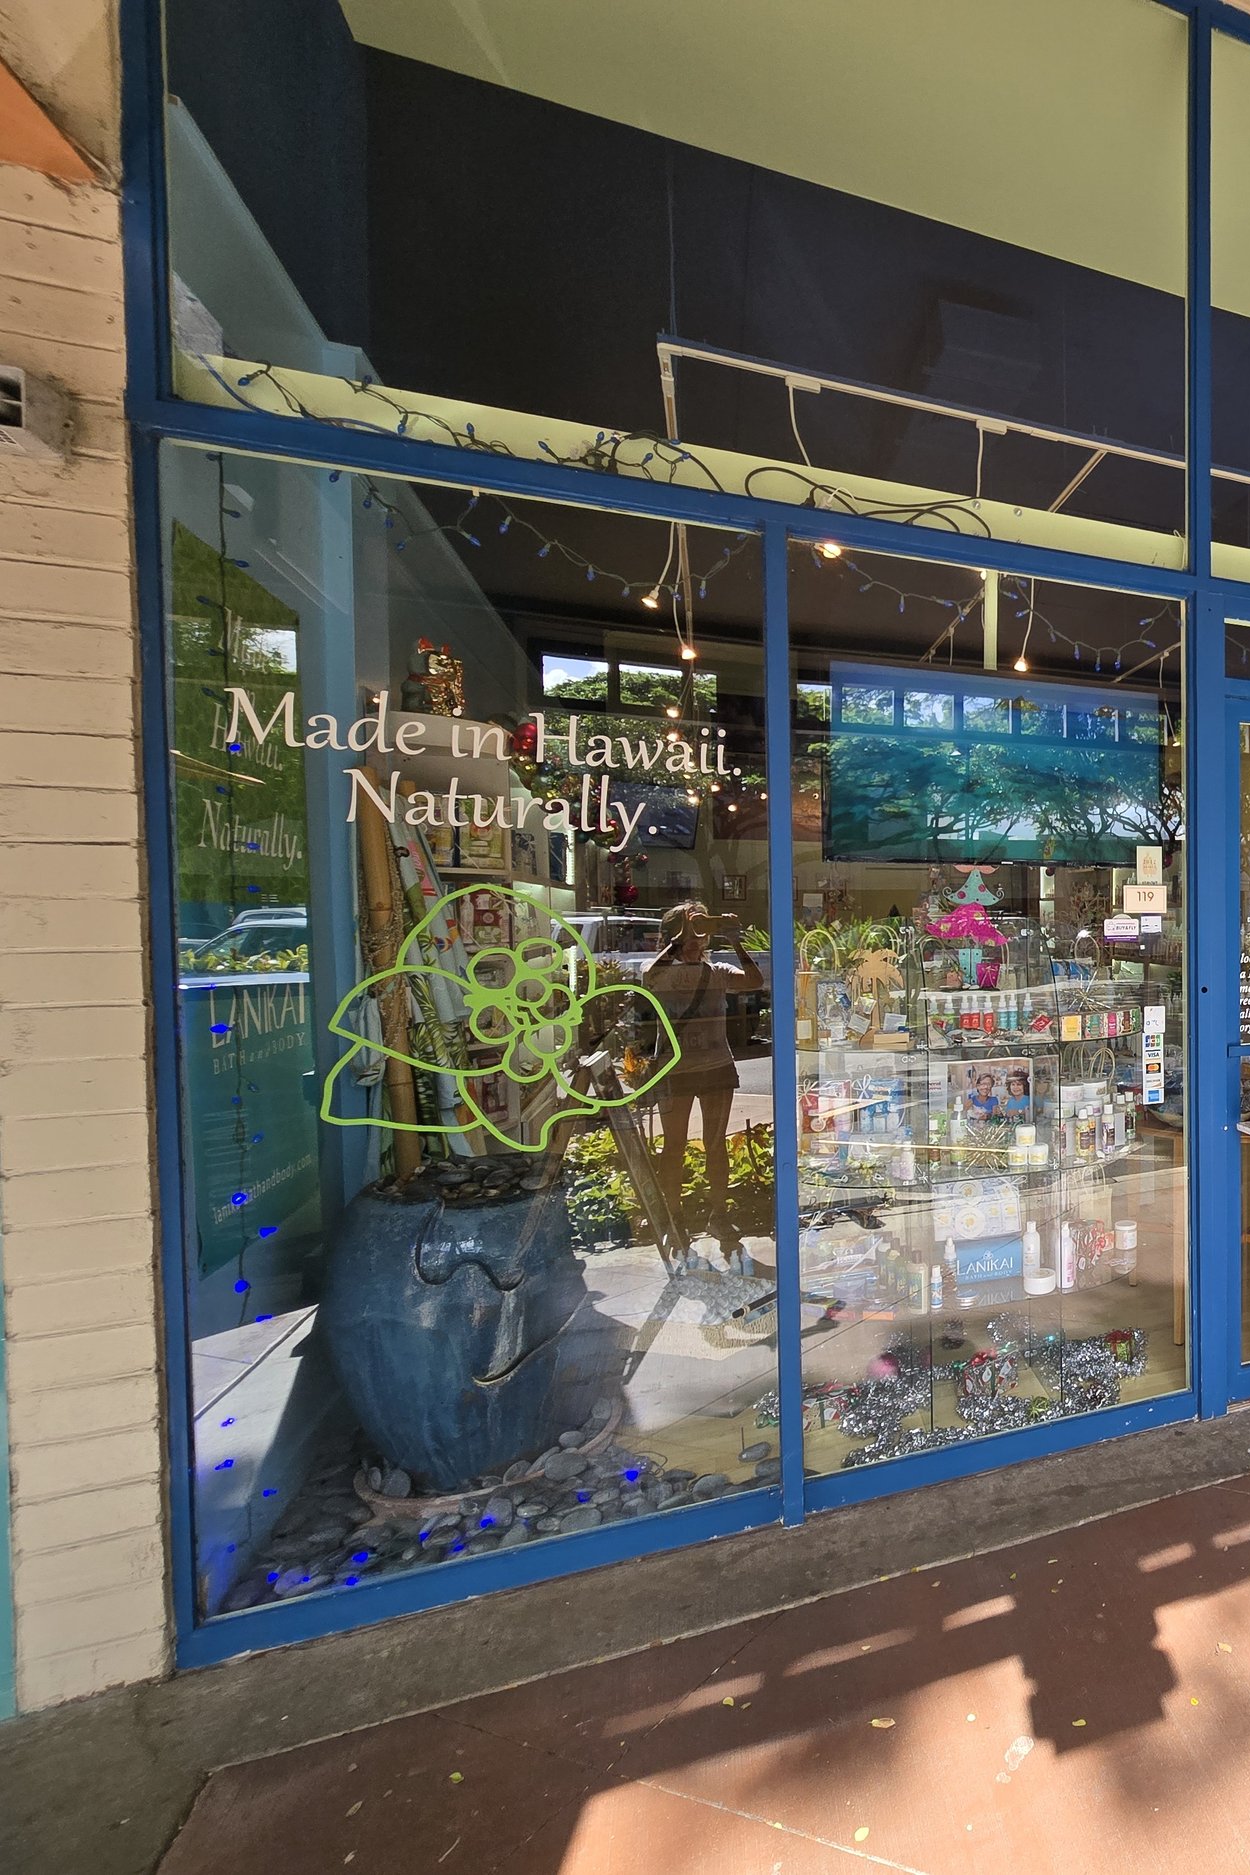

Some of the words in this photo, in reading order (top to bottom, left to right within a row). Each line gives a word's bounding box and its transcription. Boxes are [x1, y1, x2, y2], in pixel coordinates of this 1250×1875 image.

[225, 687, 427, 756] Made
[451, 707, 510, 760] in
[535, 712, 742, 778] Hawaii.
[345, 768, 658, 853] Naturally.
[1137, 891, 1155, 902] 119
[1240, 971, 1247, 979] a
[957, 1256, 1013, 1276] LANIKAI
